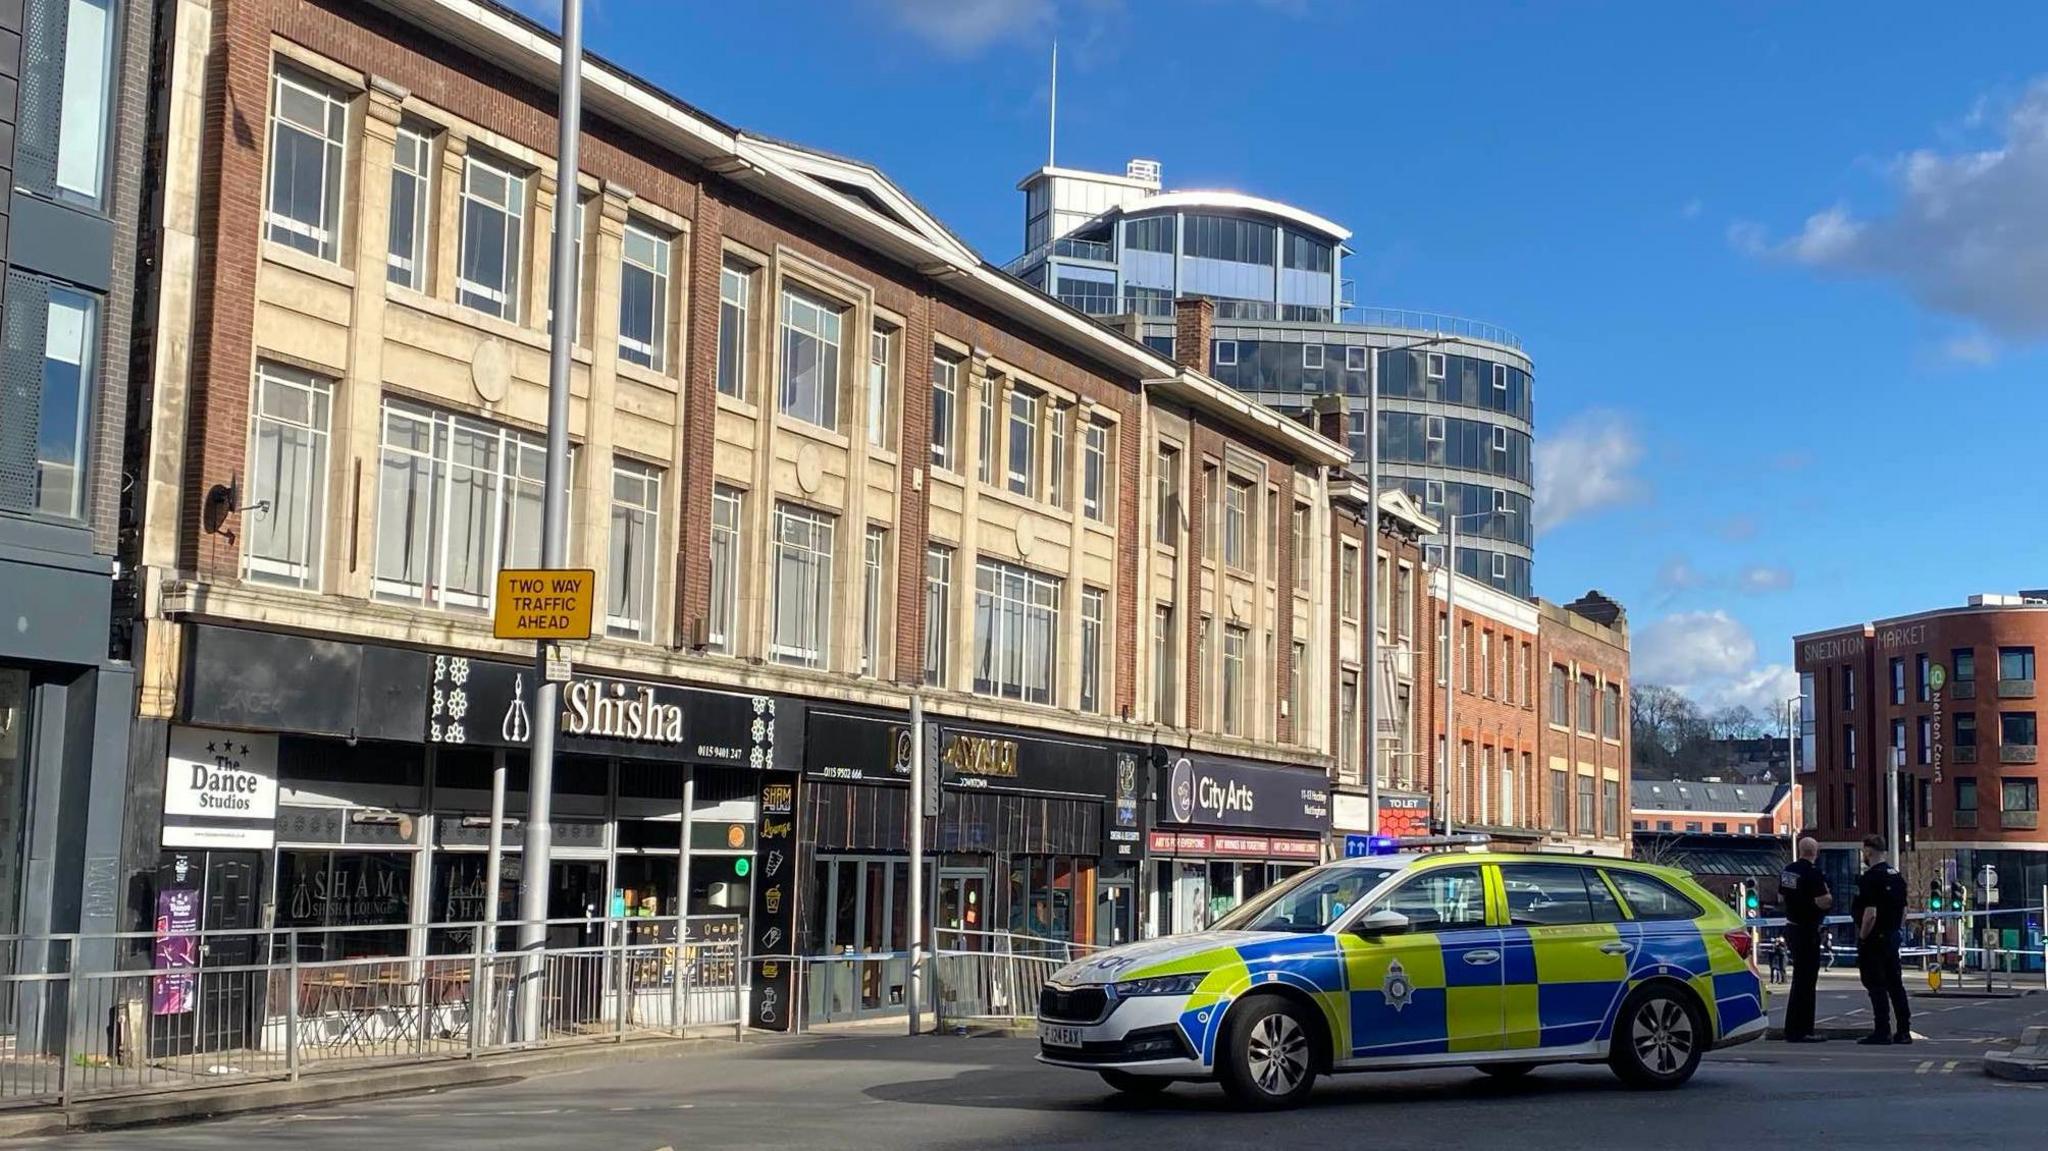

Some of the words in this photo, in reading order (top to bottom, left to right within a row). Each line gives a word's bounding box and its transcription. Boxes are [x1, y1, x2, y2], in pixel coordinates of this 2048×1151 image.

[509, 579, 544, 594] TWO
[551, 579, 582, 593] WAY
[513, 597, 577, 611] TRAFFIC
[517, 615, 570, 629] AHEAD
[1804, 637, 1864, 662] SNEINTON
[1877, 625, 1926, 649] MARKET
[563, 680, 684, 743] Shisha
[1933, 692, 1943, 740] Nelson
[215, 755, 240, 771] The
[1934, 744, 1944, 783] Court
[190, 764, 258, 793] Dance
[199, 792, 250, 810] Studios
[763, 787, 791, 803] SHAM
[1200, 776, 1226, 819] City
[1226, 779, 1253, 812] Arts
[1389, 799, 1402, 809] TO
[1402, 799, 1419, 809] LET
[314, 871, 395, 899] SHAM
[312, 902, 352, 917] SHSHA
[354, 901, 394, 915] LOUNGE
